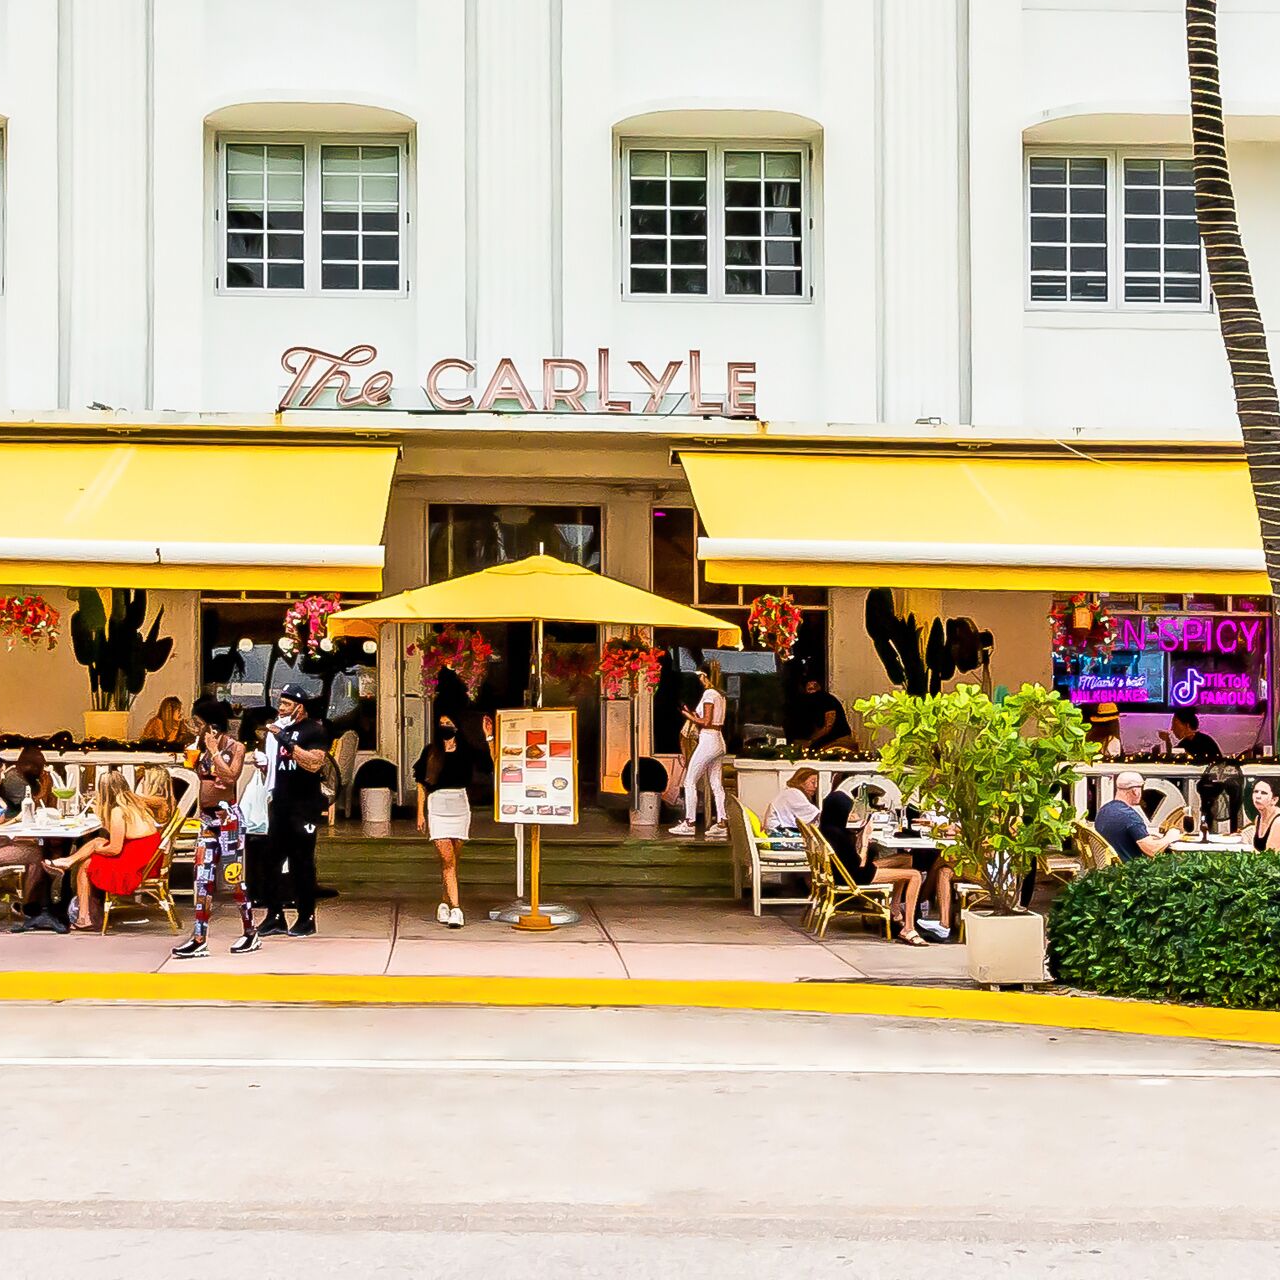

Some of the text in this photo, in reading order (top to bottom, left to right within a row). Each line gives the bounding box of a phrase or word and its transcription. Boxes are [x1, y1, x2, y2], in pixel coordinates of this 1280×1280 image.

[279, 344, 757, 414] The CARLYLE
[1071, 688, 1149, 703] MILKSHAKES
[1200, 690, 1255, 705] FAMOUS
